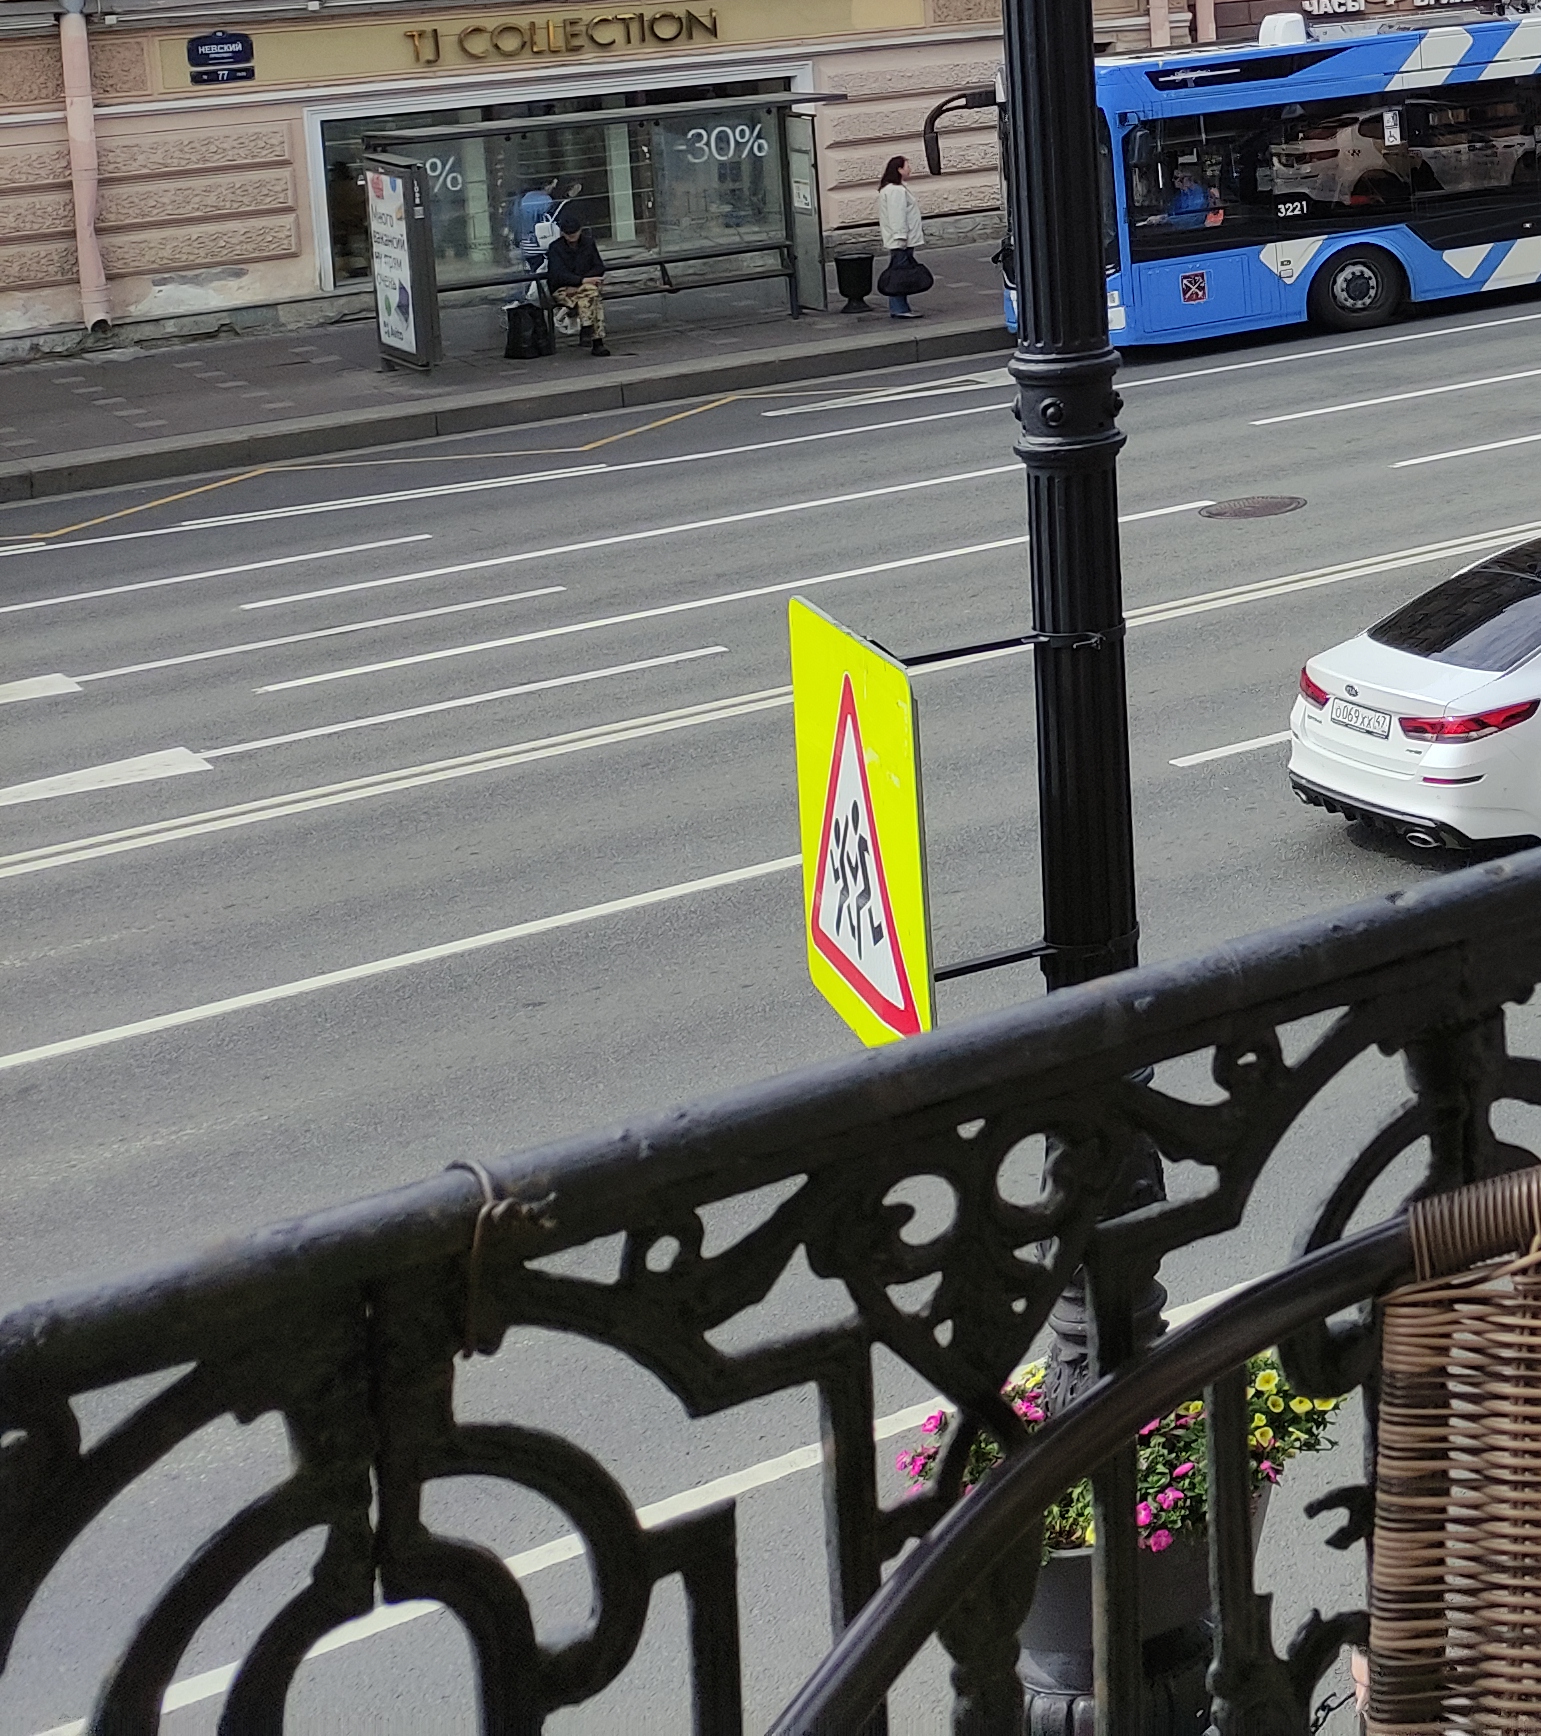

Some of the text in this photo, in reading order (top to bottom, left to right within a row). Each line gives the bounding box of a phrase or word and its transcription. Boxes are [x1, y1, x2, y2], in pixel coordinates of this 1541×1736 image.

[404, 8, 718, 63] TJ COLLECTION
[198, 41, 243, 55] НЕВСКИЙ
[217, 70, 229, 81] 77
[674, 123, 769, 163] -30%
[1277, 200, 1307, 217] 3221
